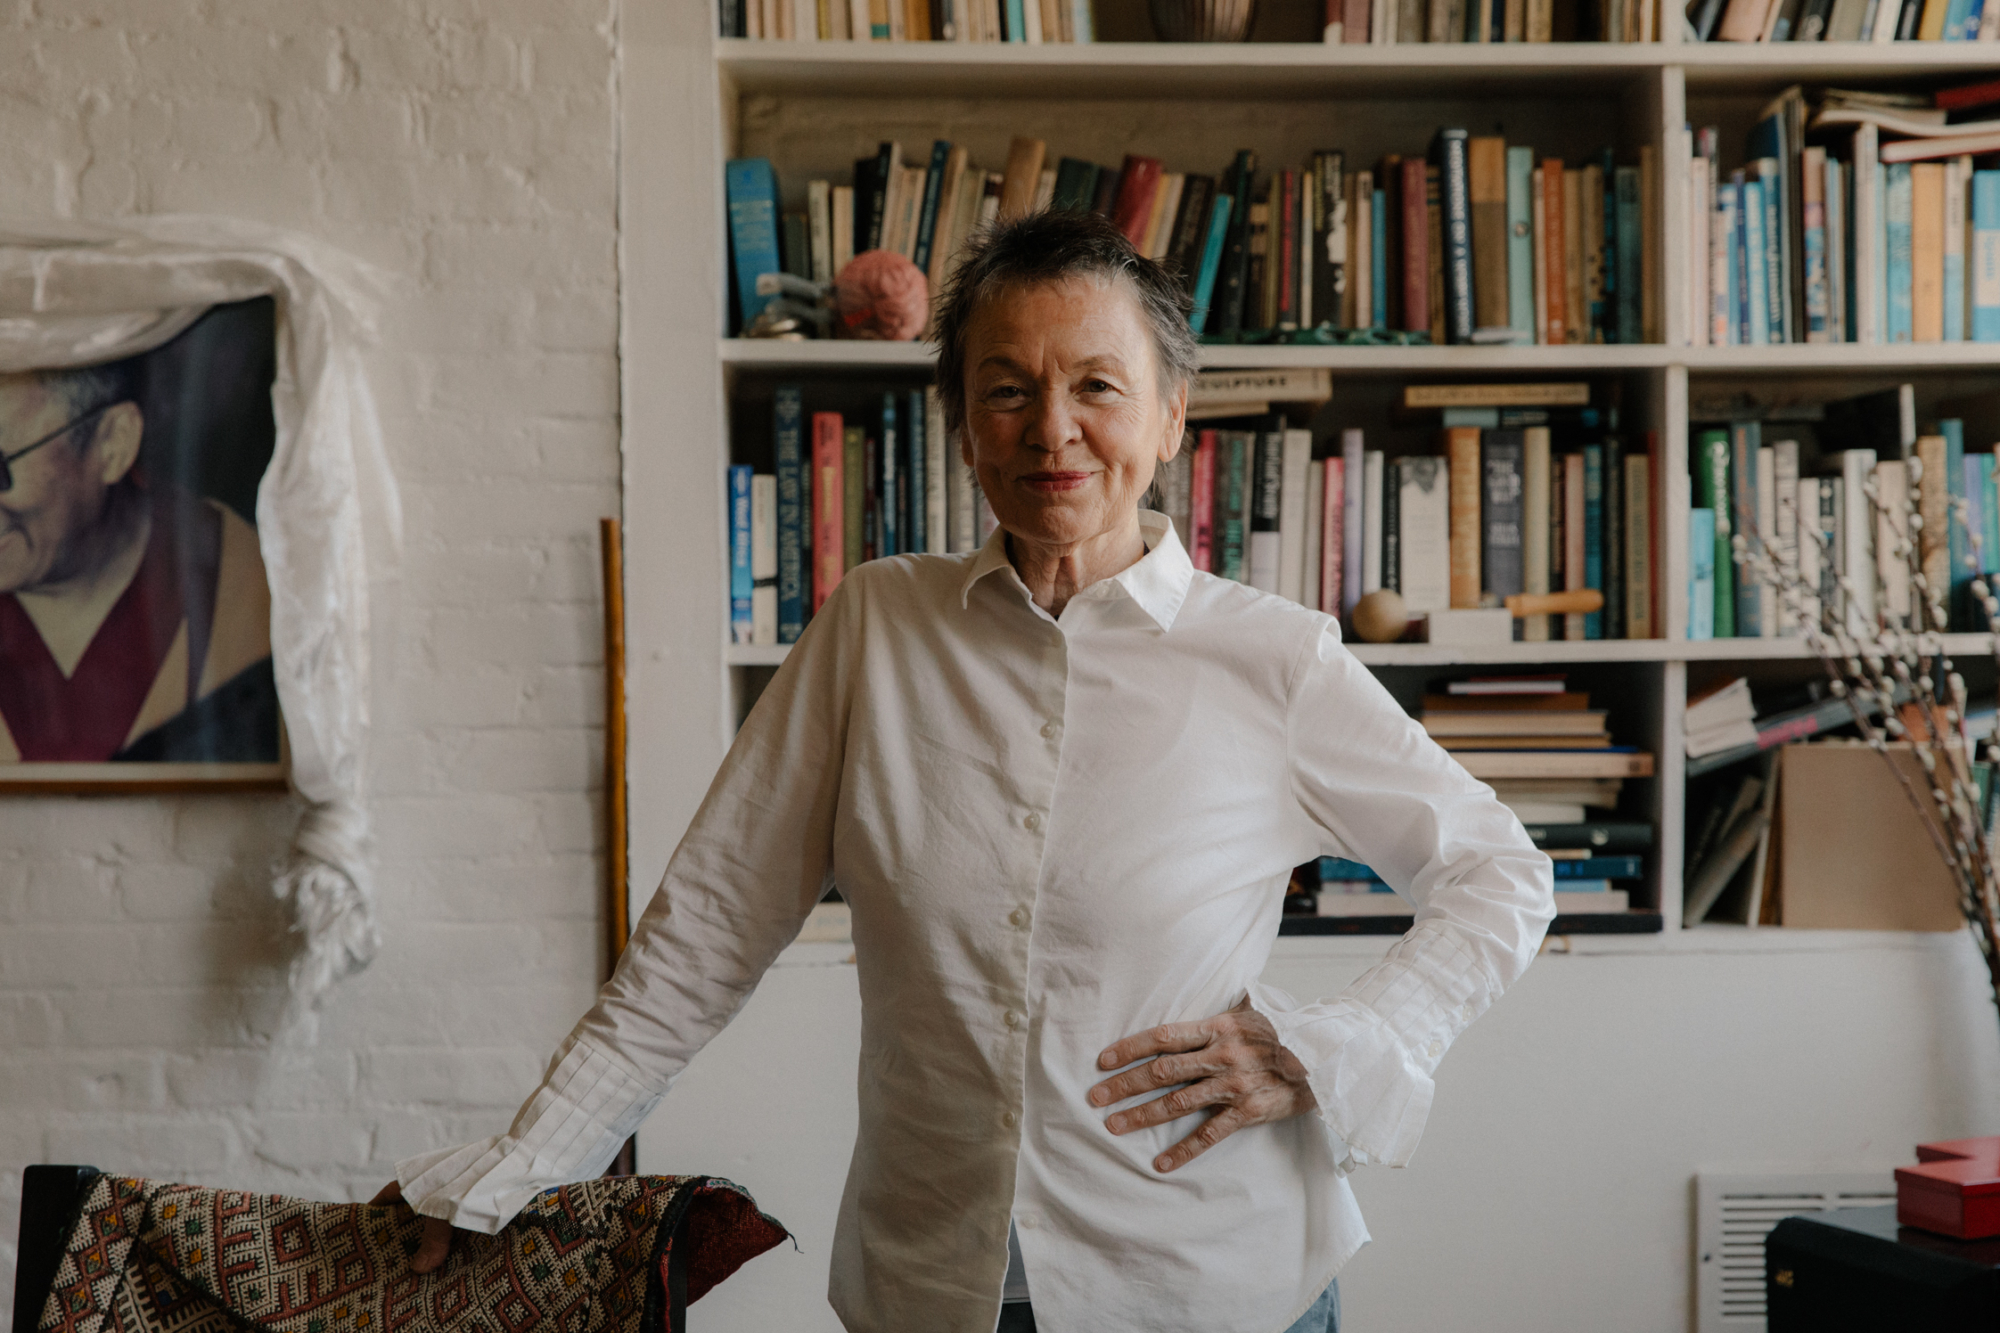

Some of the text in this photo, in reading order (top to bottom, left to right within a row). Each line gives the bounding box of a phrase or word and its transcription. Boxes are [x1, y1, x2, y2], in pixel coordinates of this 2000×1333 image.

[1197, 374, 1288, 390] CULPTURE
[779, 427, 800, 462] THE
[780, 466, 800, 501] LAW
[735, 495, 750, 528] West
[780, 504, 800, 525] IN
[735, 530, 749, 567] Africa
[780, 529, 802, 602] AMERICA
